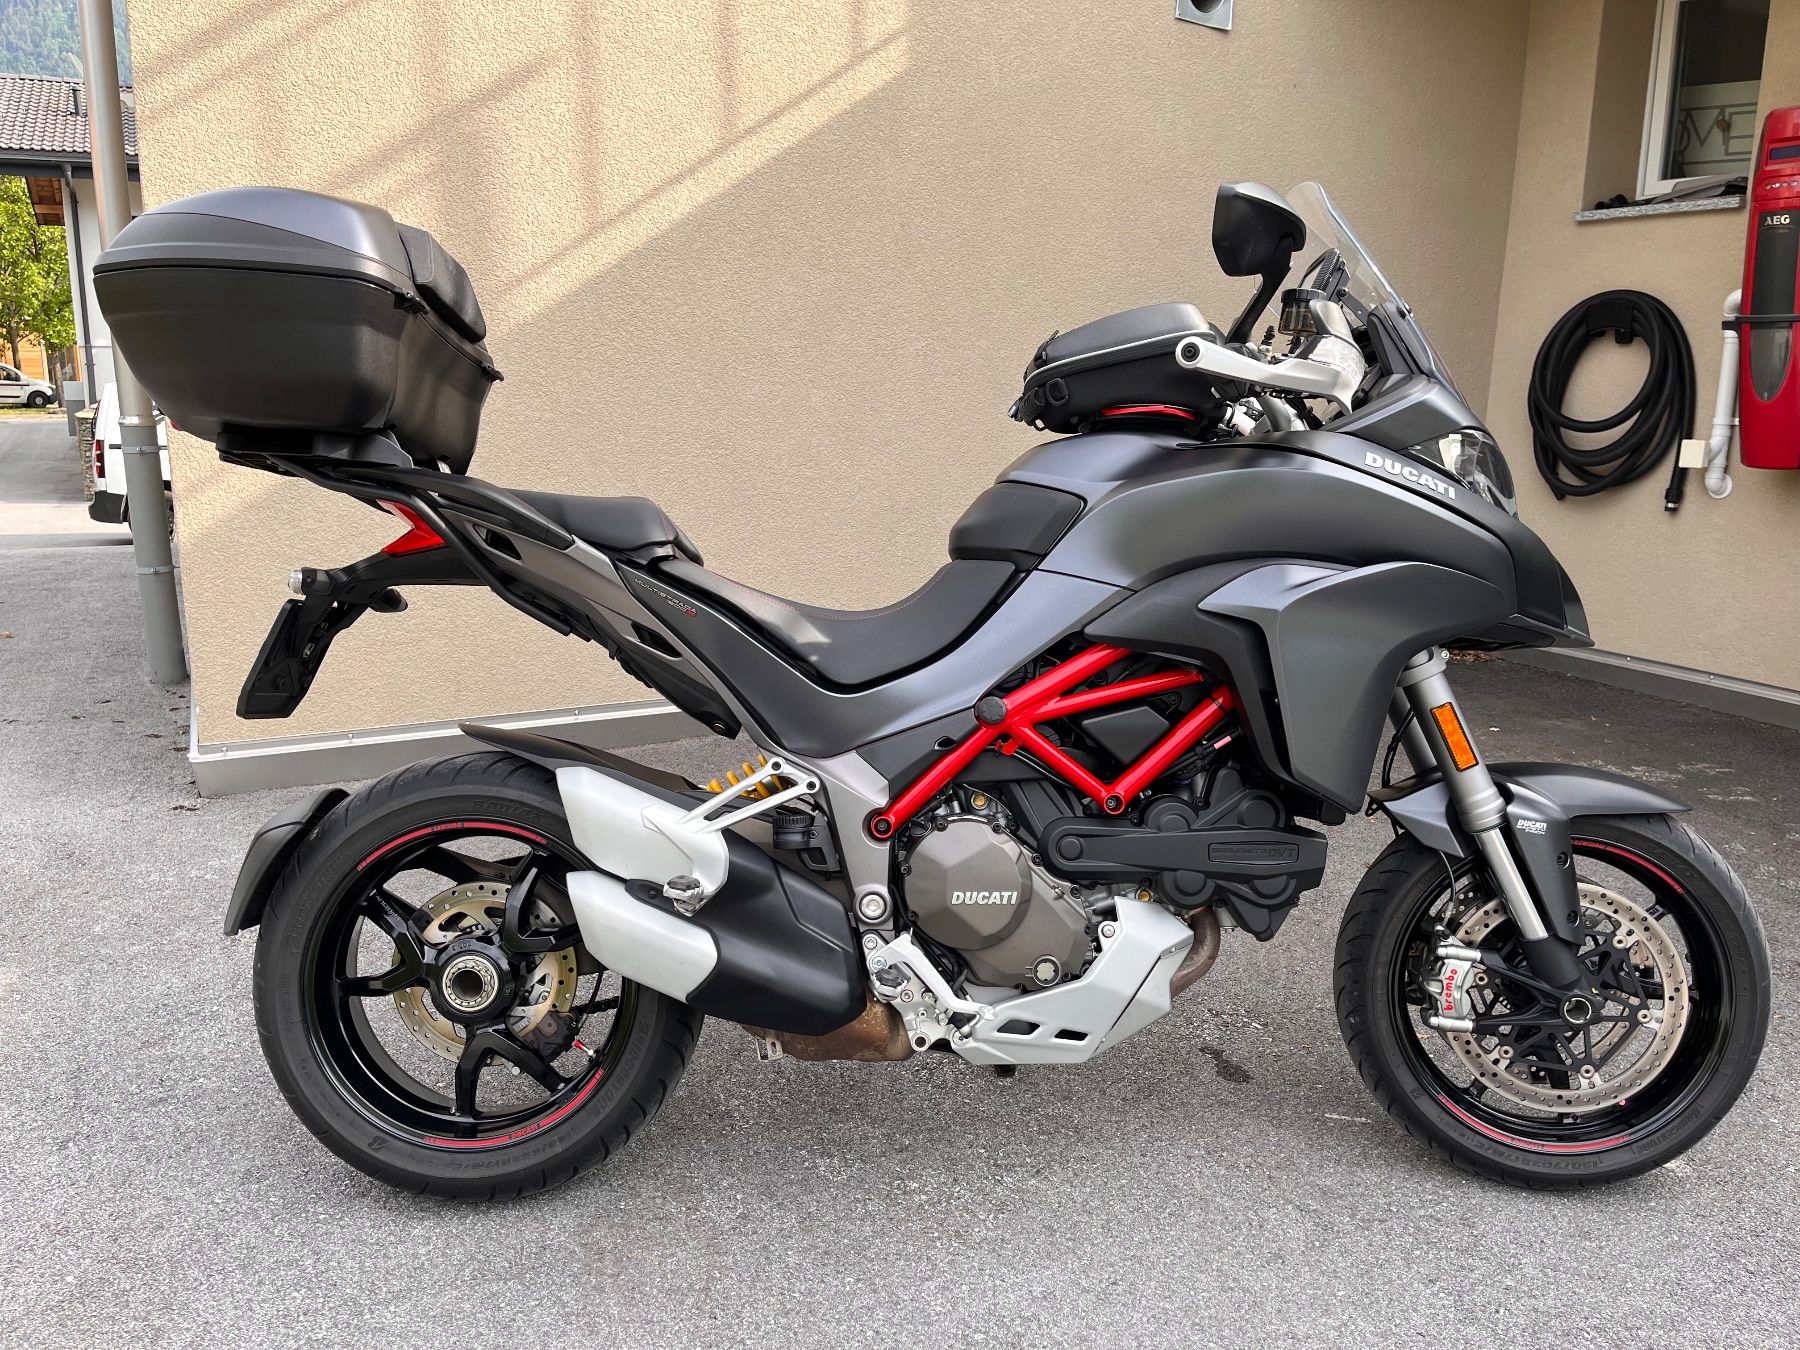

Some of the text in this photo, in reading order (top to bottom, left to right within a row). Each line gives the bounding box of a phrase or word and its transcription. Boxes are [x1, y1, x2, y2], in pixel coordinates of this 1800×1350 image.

[1764, 214, 1790, 226] AEG
[1365, 451, 1456, 500] DUCATI
[1516, 819, 1548, 829] DUCATI
[951, 891, 1018, 905] DUCATI
[1443, 968, 1458, 1011] brembo
[511, 1124, 540, 1142] DUCATI
